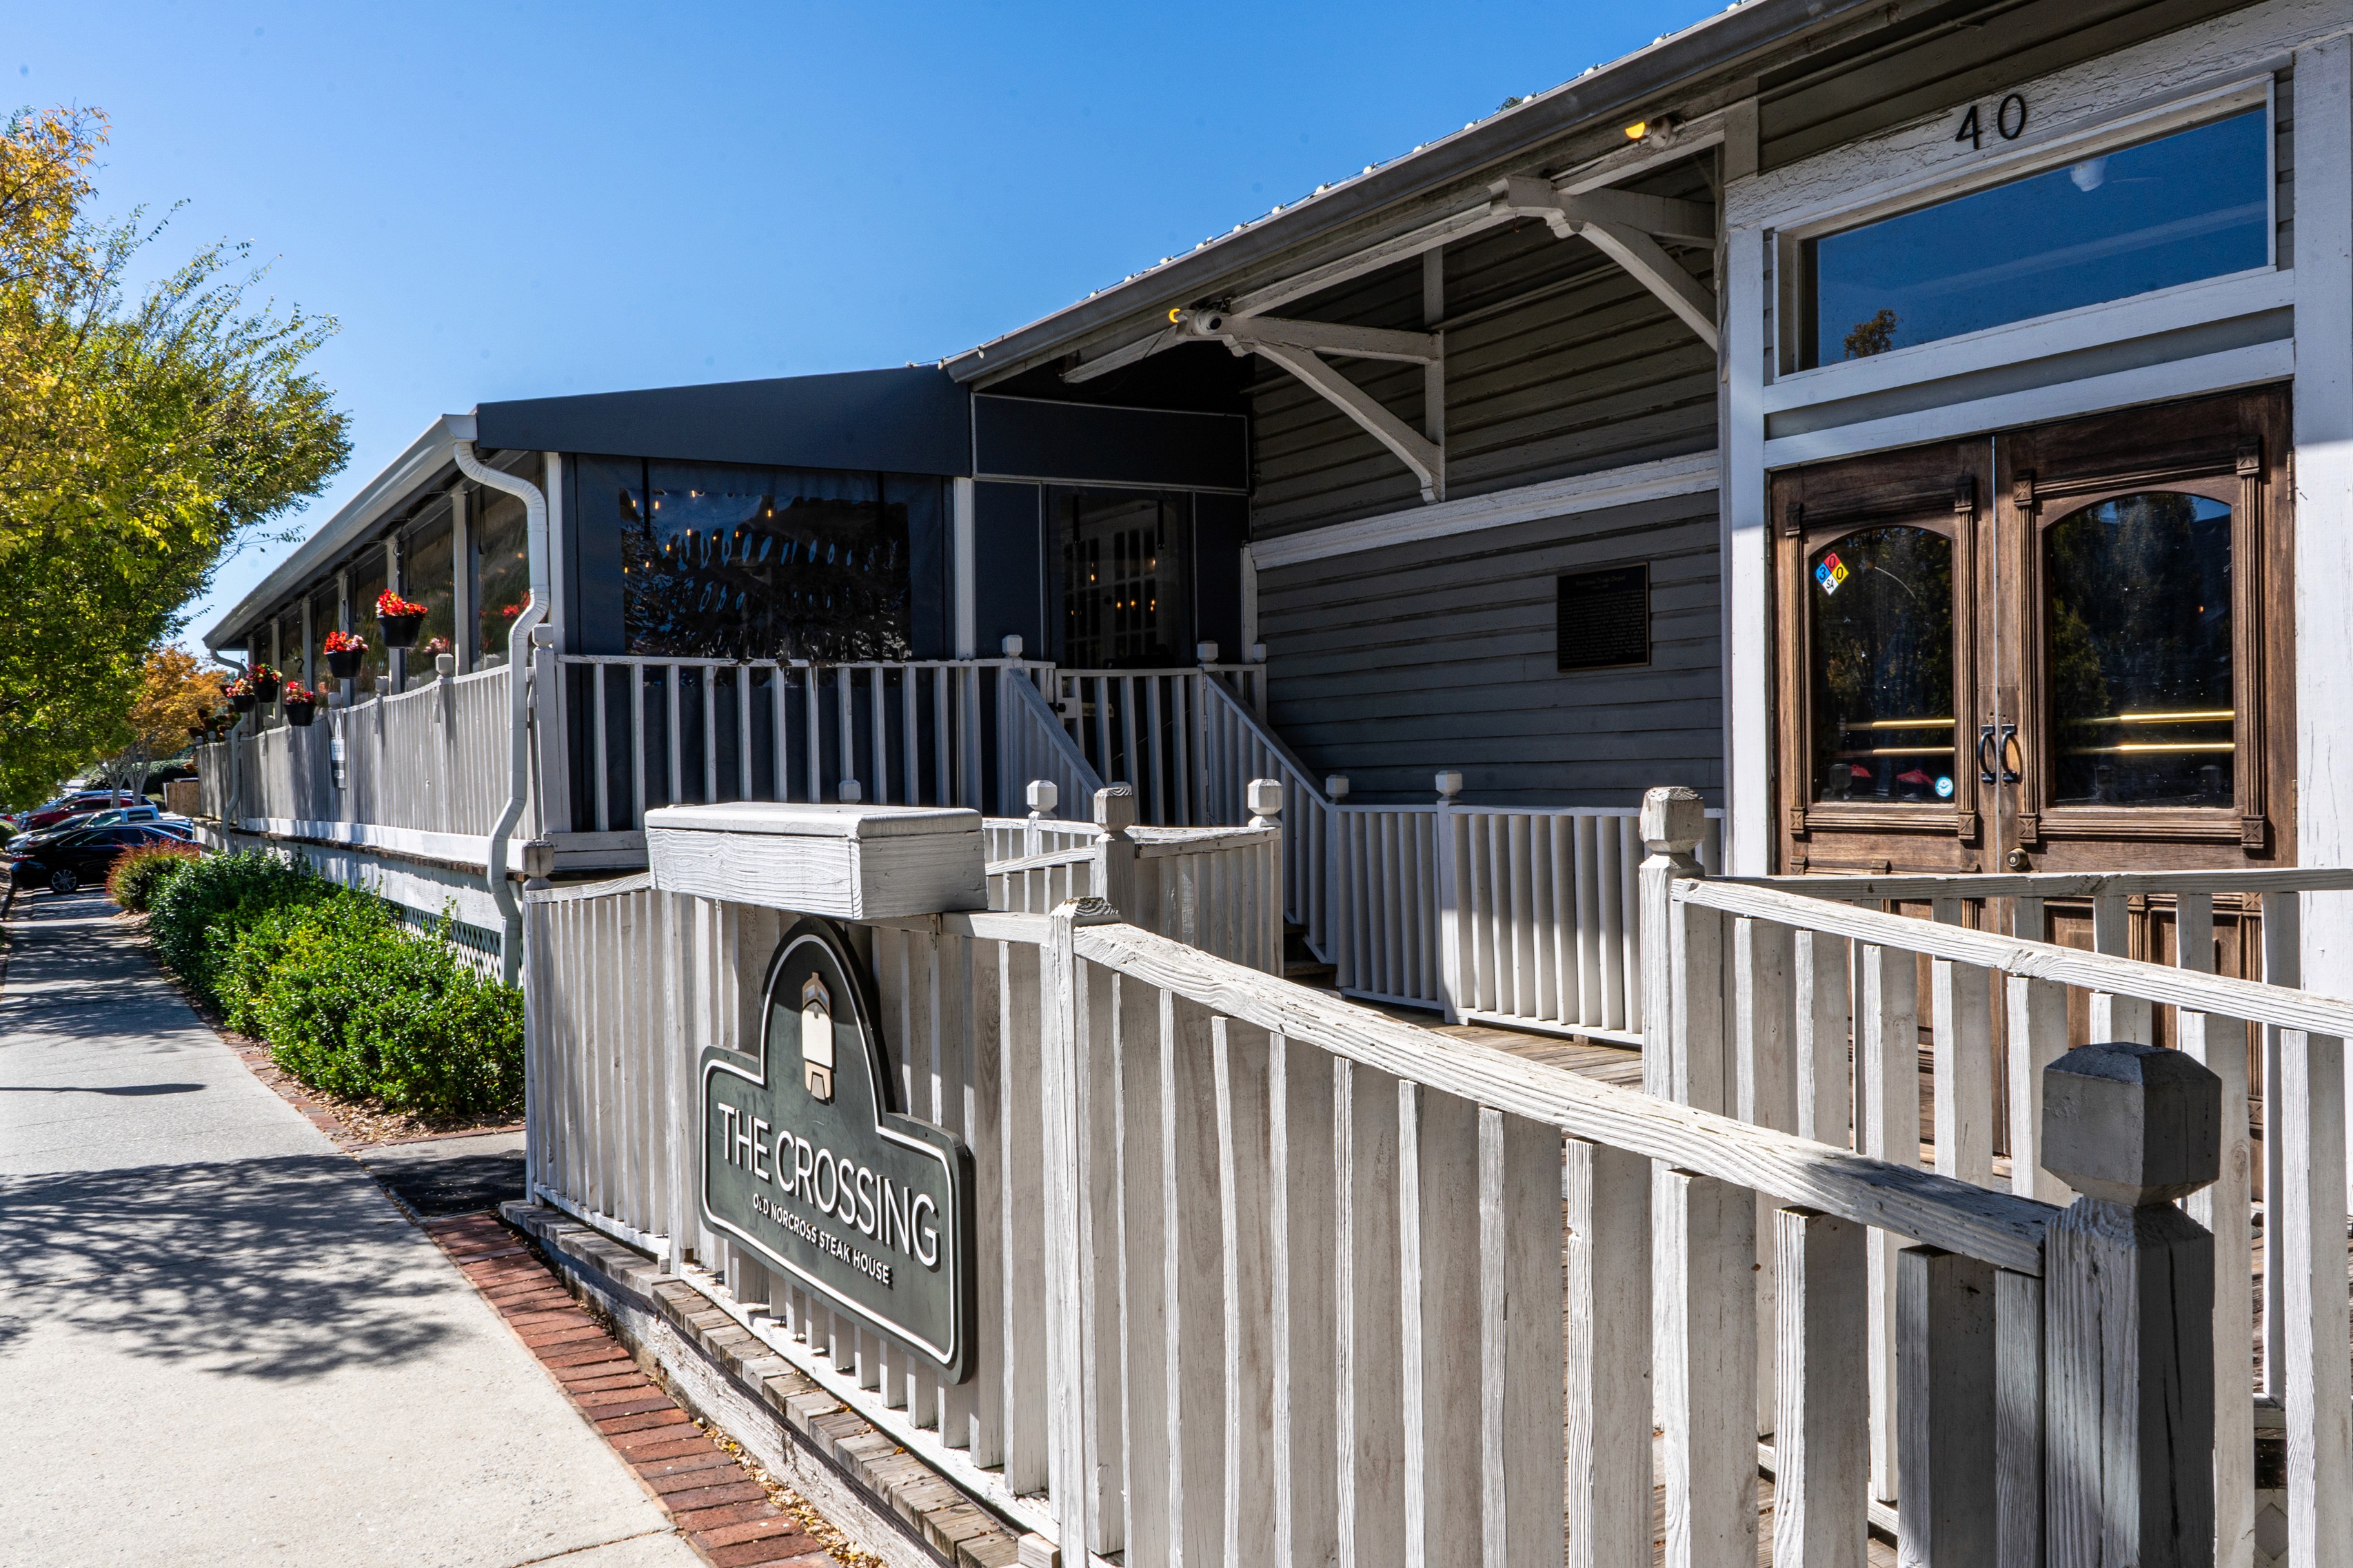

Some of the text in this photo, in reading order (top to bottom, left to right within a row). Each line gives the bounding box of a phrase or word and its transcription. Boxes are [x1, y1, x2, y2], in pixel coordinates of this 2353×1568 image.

[1955, 94, 2026, 150] 40
[1828, 556, 1836, 569] 0
[1819, 567, 1826, 580] 3
[1836, 567, 1844, 580] 0
[1826, 579, 1834, 589] SA
[718, 1102, 939, 1267] THE CROSSING
[753, 1193, 891, 1285] OLD NORCROSS STEAK HOUSE
